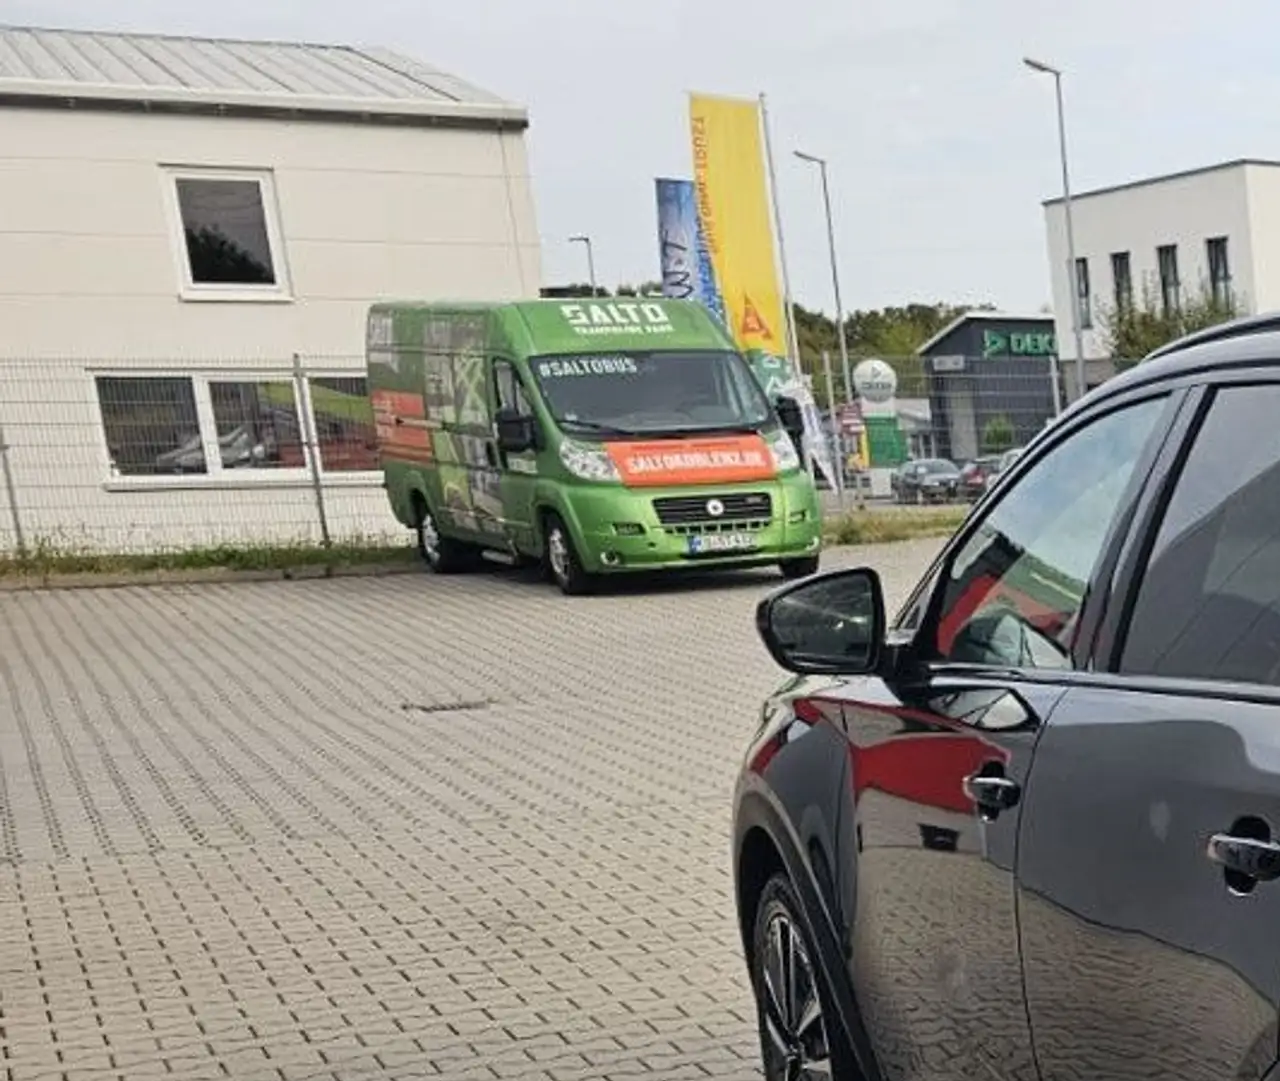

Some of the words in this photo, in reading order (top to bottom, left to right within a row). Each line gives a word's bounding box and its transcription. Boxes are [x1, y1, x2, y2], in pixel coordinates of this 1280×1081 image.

[560, 303, 670, 325] SALTO
[1010, 333, 1058, 353] DEK
[540, 357, 637, 377] #SALTOBUS
